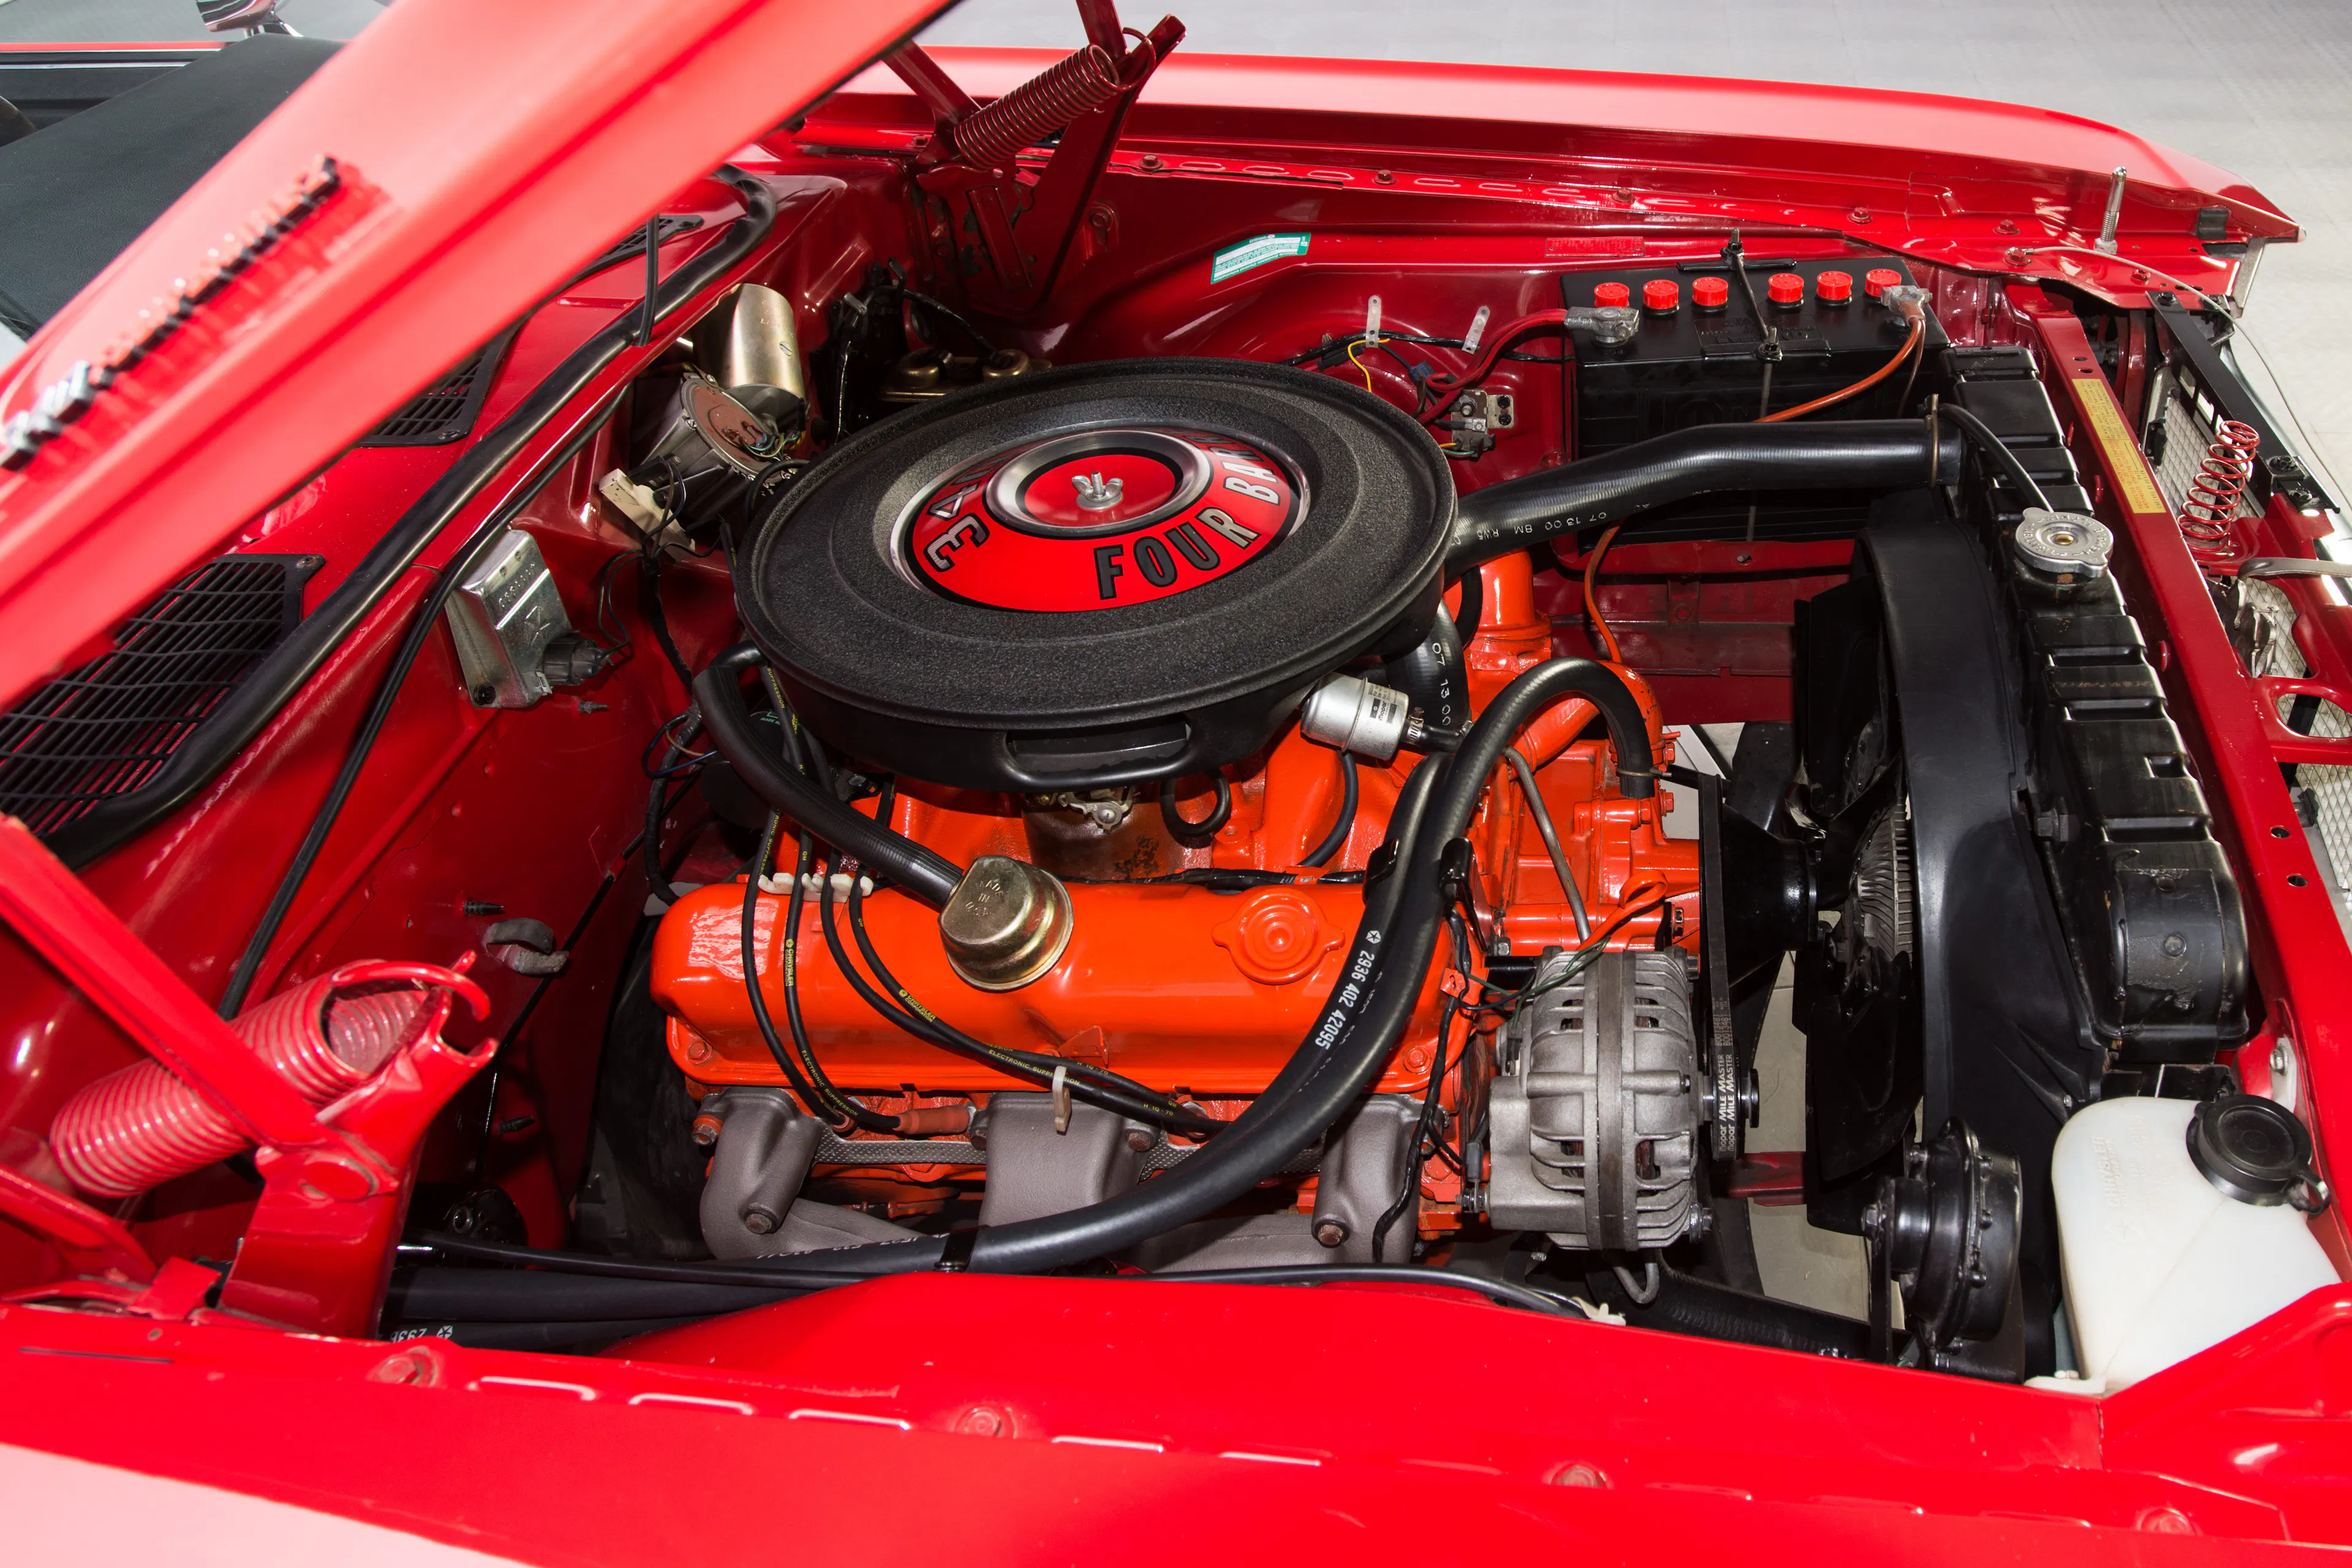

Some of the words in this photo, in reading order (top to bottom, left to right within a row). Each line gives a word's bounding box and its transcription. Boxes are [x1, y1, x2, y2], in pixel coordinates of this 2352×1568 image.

[1167, 429, 1281, 507] BARR
[1093, 507, 1262, 600] FOUR
[767, 667, 786, 709] SUPPRESSION
[771, 810, 780, 835] RONIC
[758, 838, 774, 876] SUPPRESSIO
[802, 850, 808, 862] QM
[978, 893, 991, 903] IN
[1351, 949, 1376, 982] 2936
[905, 997, 934, 1023] CORPORATION
[907, 994, 937, 1020] CHRYSLER
[1337, 982, 1361, 1009] 402
[1314, 1008, 1347, 1051] 42095
[801, 1049, 825, 1088] ELECTRONIC
[824, 1088, 859, 1117] SUPPRESSION
[988, 1049, 1030, 1069] ELECTRONIC
[1031, 1065, 1081, 1086] SUPPSION
[1717, 1054, 1727, 1093] MASTER
[1725, 1054, 1735, 1092] MASTER
[1719, 1095, 1727, 1122] MILE
[1726, 1095, 1735, 1121] MILE
